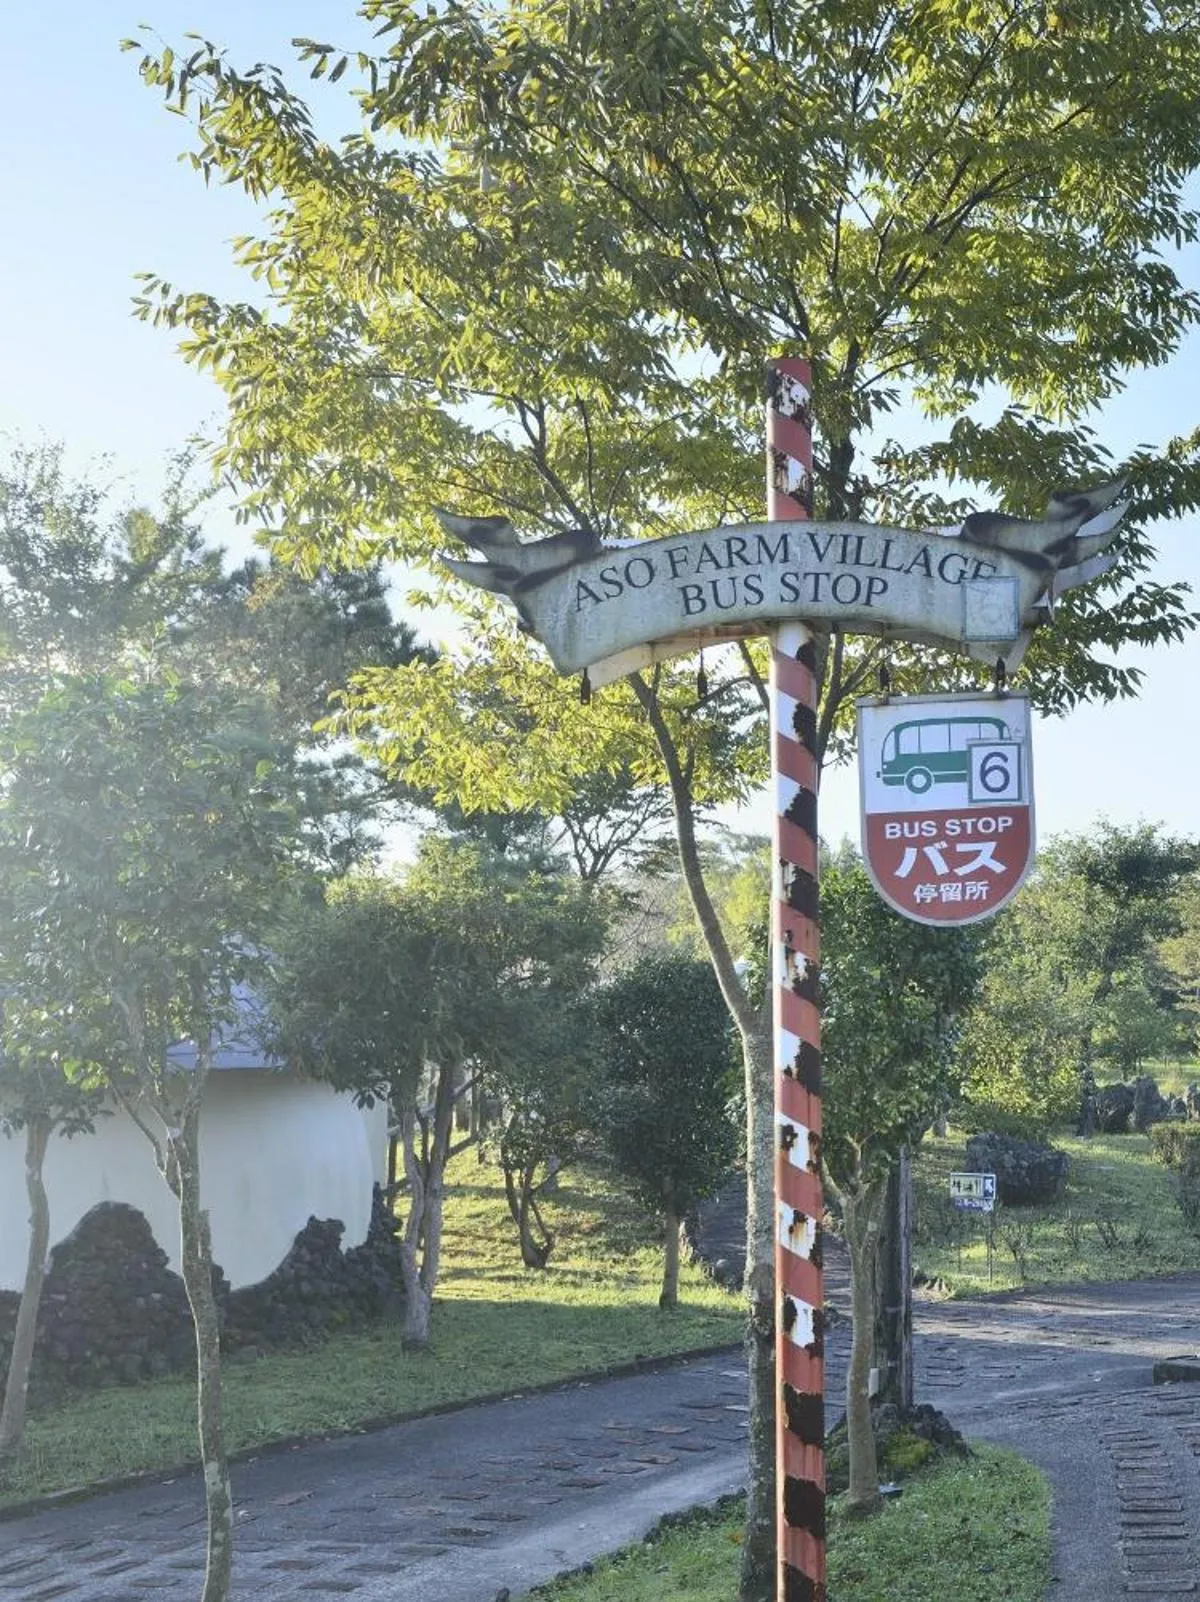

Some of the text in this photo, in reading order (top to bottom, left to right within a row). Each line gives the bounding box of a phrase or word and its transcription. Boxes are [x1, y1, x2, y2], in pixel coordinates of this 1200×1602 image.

[575, 557, 656, 612] ASO
[664, 532, 792, 580] FARM
[679, 571, 889, 617] BUS STOP
[979, 751, 1011, 793] 6
[884, 816, 1014, 840] BUS STOP
[893, 840, 1008, 879] バス
[913, 880, 992, 905] 停留所
